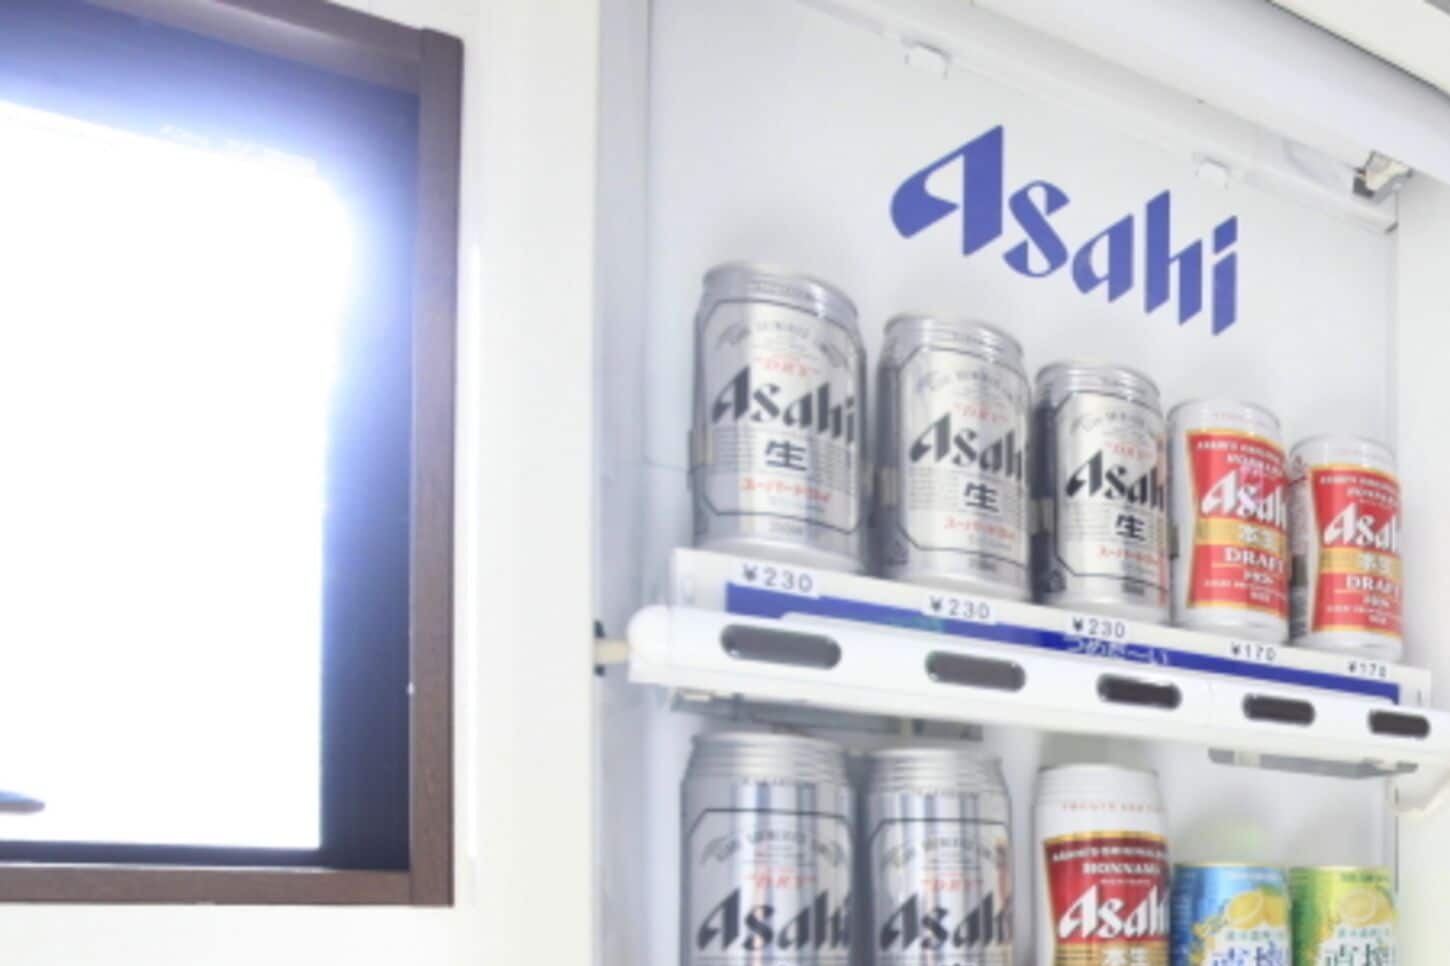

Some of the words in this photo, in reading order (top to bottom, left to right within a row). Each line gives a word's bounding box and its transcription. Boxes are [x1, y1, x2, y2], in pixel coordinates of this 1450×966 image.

[890, 124, 1237, 335] Asahi
[712, 366, 855, 445] Asahi
[765, 440, 808, 471] 生
[964, 482, 1000, 513] 生
[1115, 514, 1146, 542] 生
[742, 563, 813, 592] ¥230
[929, 595, 991, 619] ¥230
[1072, 616, 1126, 639] ¥230
[1231, 641, 1277, 661] ¥170
